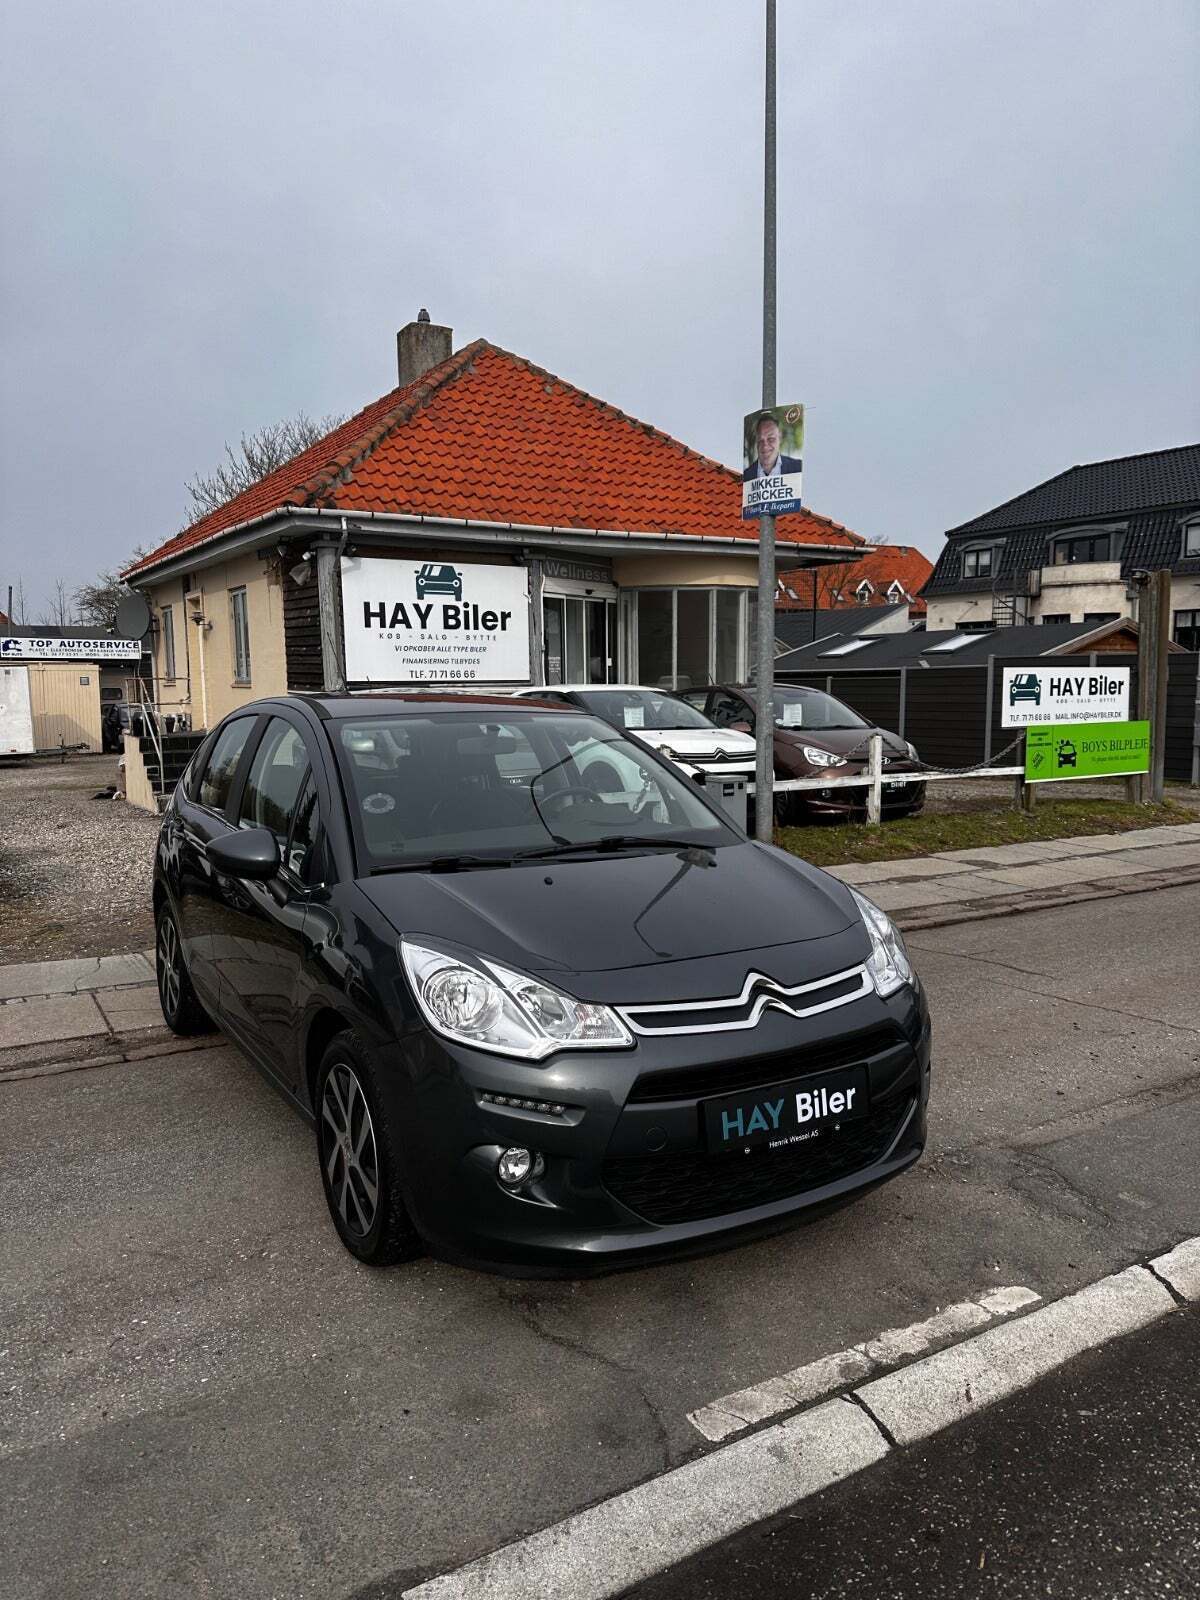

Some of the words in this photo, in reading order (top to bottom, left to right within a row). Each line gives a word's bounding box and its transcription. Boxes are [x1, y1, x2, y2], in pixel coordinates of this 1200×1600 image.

[752, 477, 787, 491] MIKKEL
[748, 488, 793, 504] DENCKER
[546, 561, 609, 583] Wellness
[363, 601, 433, 629] HAY
[443, 602, 511, 631] Biler
[60, 640, 139, 649] AUTOSERVICE
[409, 670, 427, 678] TLF.
[429, 670, 437, 678] 71
[440, 670, 447, 678] 71
[1050, 678, 1085, 696] HAY
[1089, 675, 1124, 695] Biler
[1082, 740, 1108, 753] BOYS
[721, 1098, 785, 1140] HAY
[795, 1087, 856, 1124] Biler
[769, 1138, 788, 1148] Henrik
[789, 1132, 809, 1143] Wessel
[811, 1130, 819, 1138] AS
